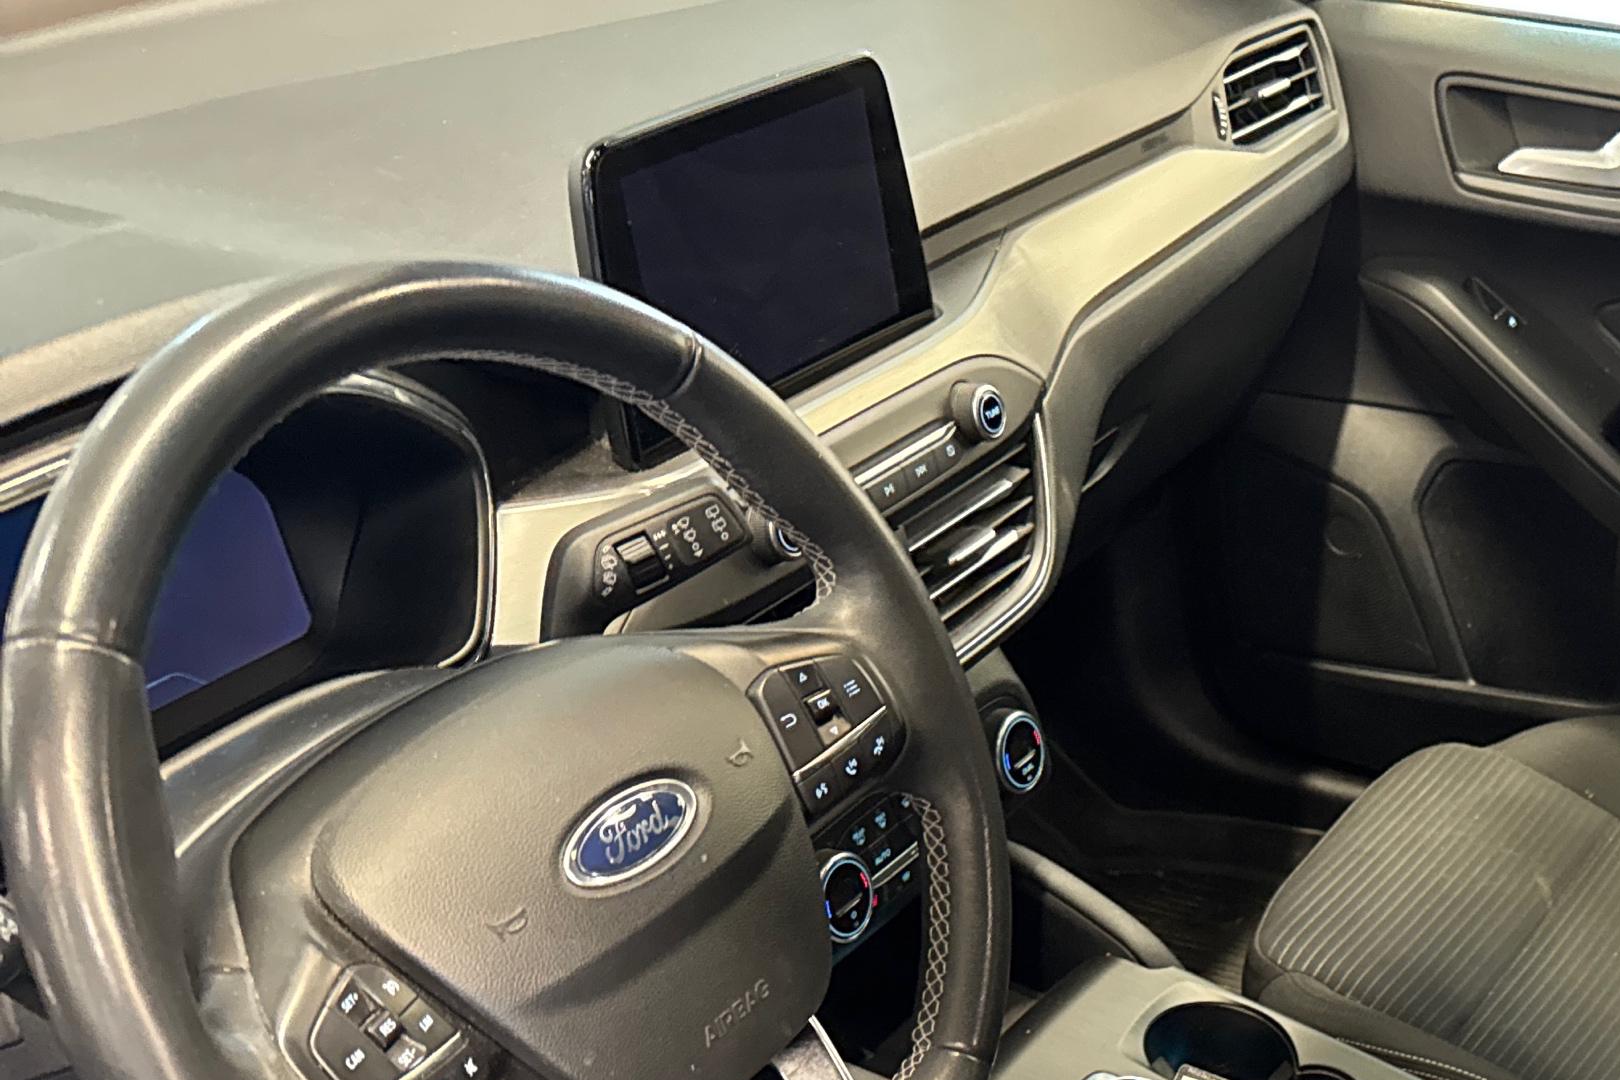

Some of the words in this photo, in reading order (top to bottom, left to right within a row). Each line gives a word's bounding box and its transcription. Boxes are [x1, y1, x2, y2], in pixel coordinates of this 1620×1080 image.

[816, 698, 831, 710] OK
[599, 799, 670, 864] Ford
[704, 978, 770, 1049] AIRBAG
